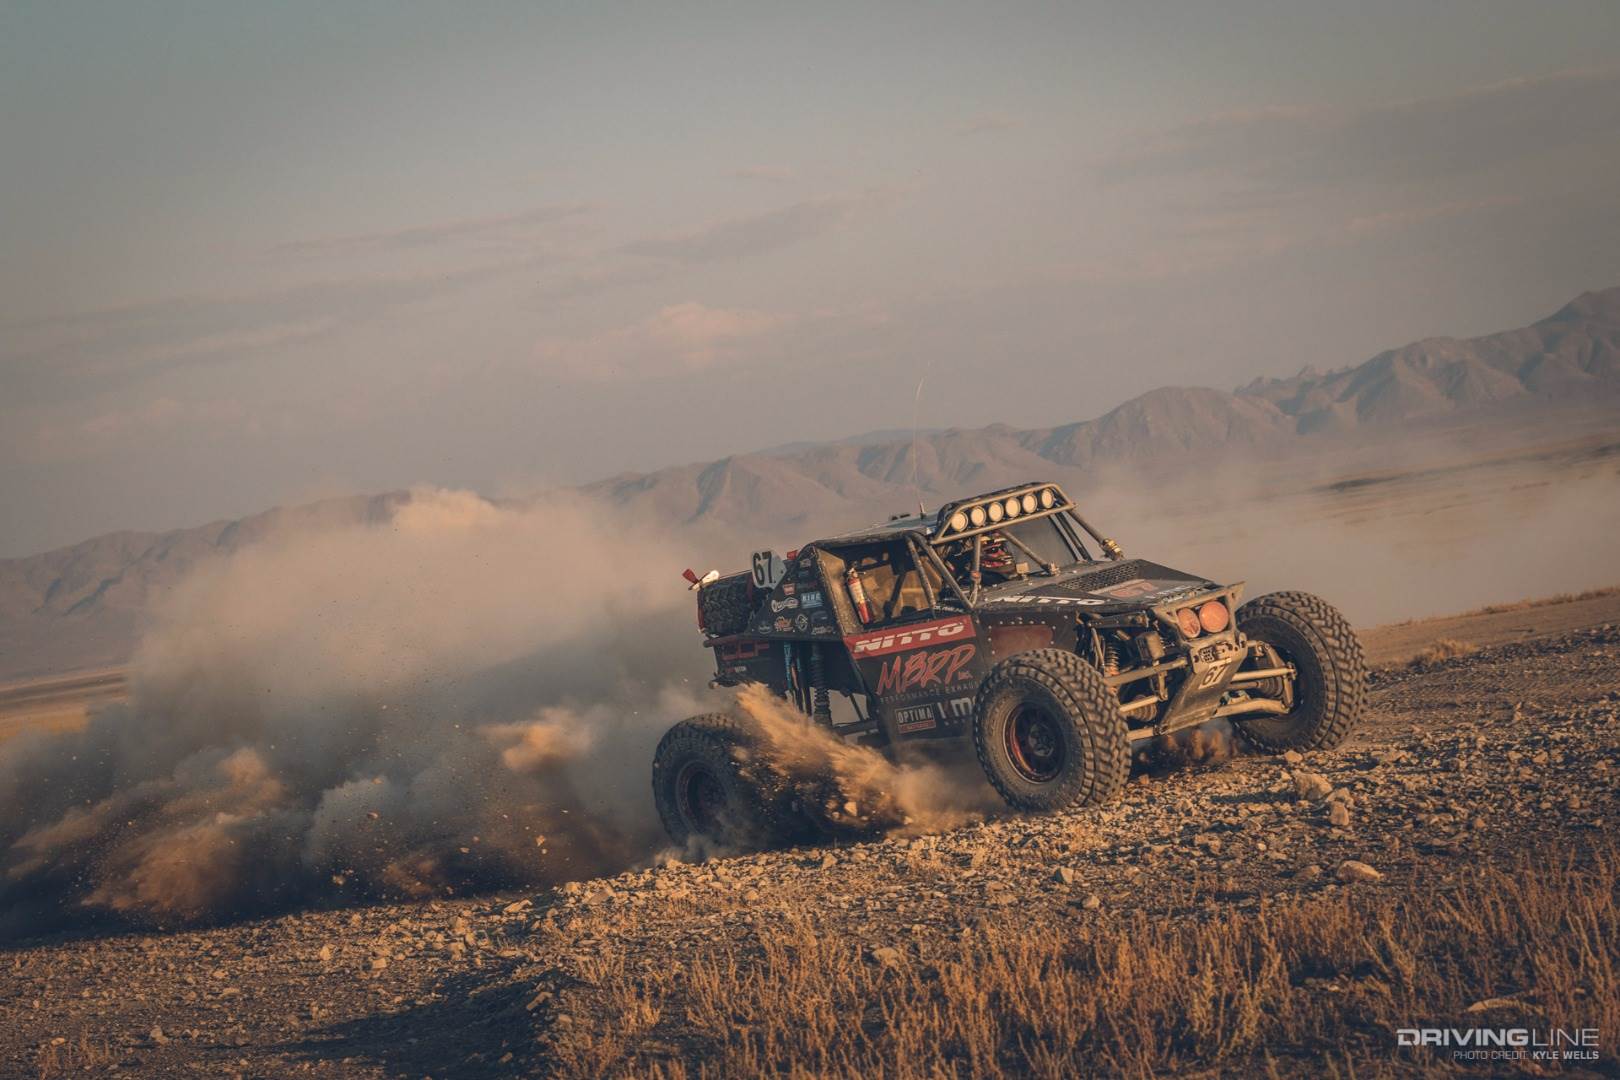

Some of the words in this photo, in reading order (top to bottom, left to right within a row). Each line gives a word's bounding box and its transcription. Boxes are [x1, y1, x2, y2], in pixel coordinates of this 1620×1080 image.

[753, 551, 773, 586] 67
[854, 622, 964, 653] NITTO
[876, 644, 976, 695] MBRP
[1203, 664, 1227, 685] 67
[897, 707, 933, 723] OPTIMA
